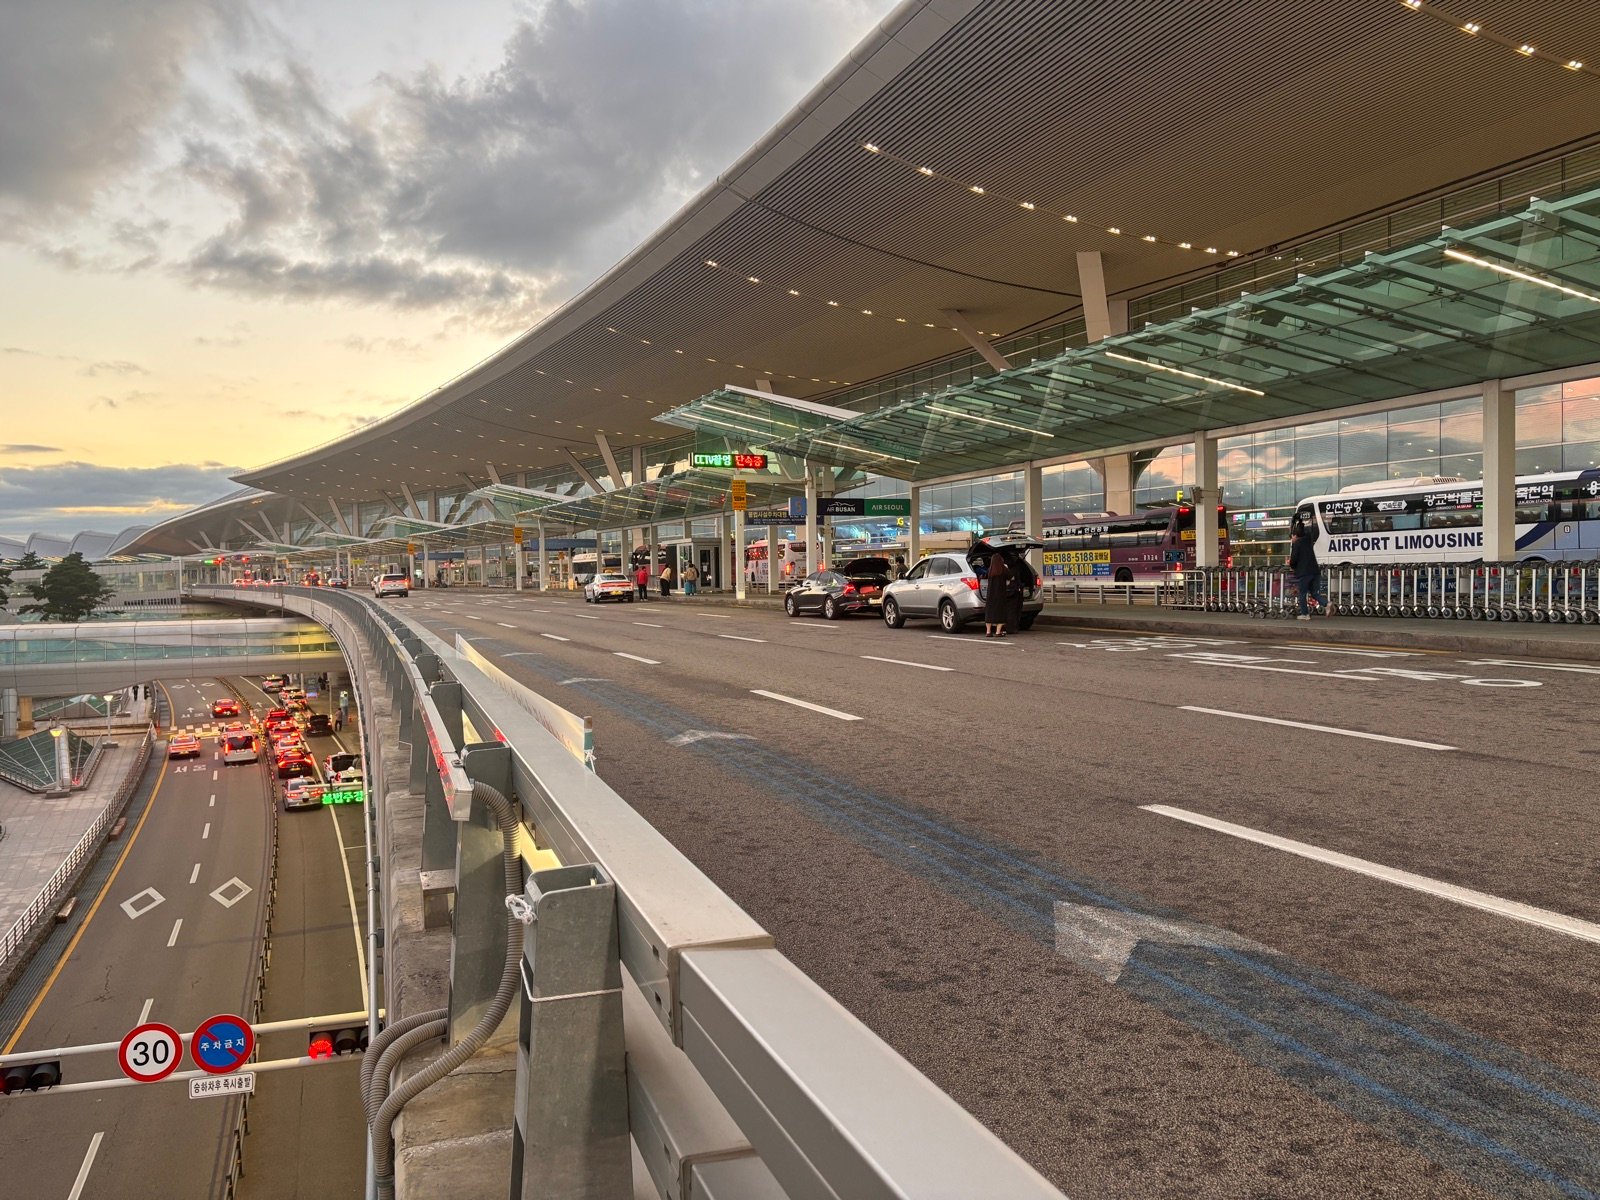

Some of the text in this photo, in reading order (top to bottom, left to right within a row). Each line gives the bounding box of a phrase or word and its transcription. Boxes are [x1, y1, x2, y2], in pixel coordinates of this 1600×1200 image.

[735, 455, 763, 467] 단속중
[1176, 490, 1184, 502] F
[1423, 490, 1484, 507] 광교박물관
[1515, 484, 1554, 500] 죽전역
[1325, 501, 1363, 514] 인천공항
[1328, 531, 1484, 553] AIRPORT LIMOUSINE
[132, 1039, 170, 1067] 30
[193, 1076, 251, 1094] 승하차후 즉시출발
